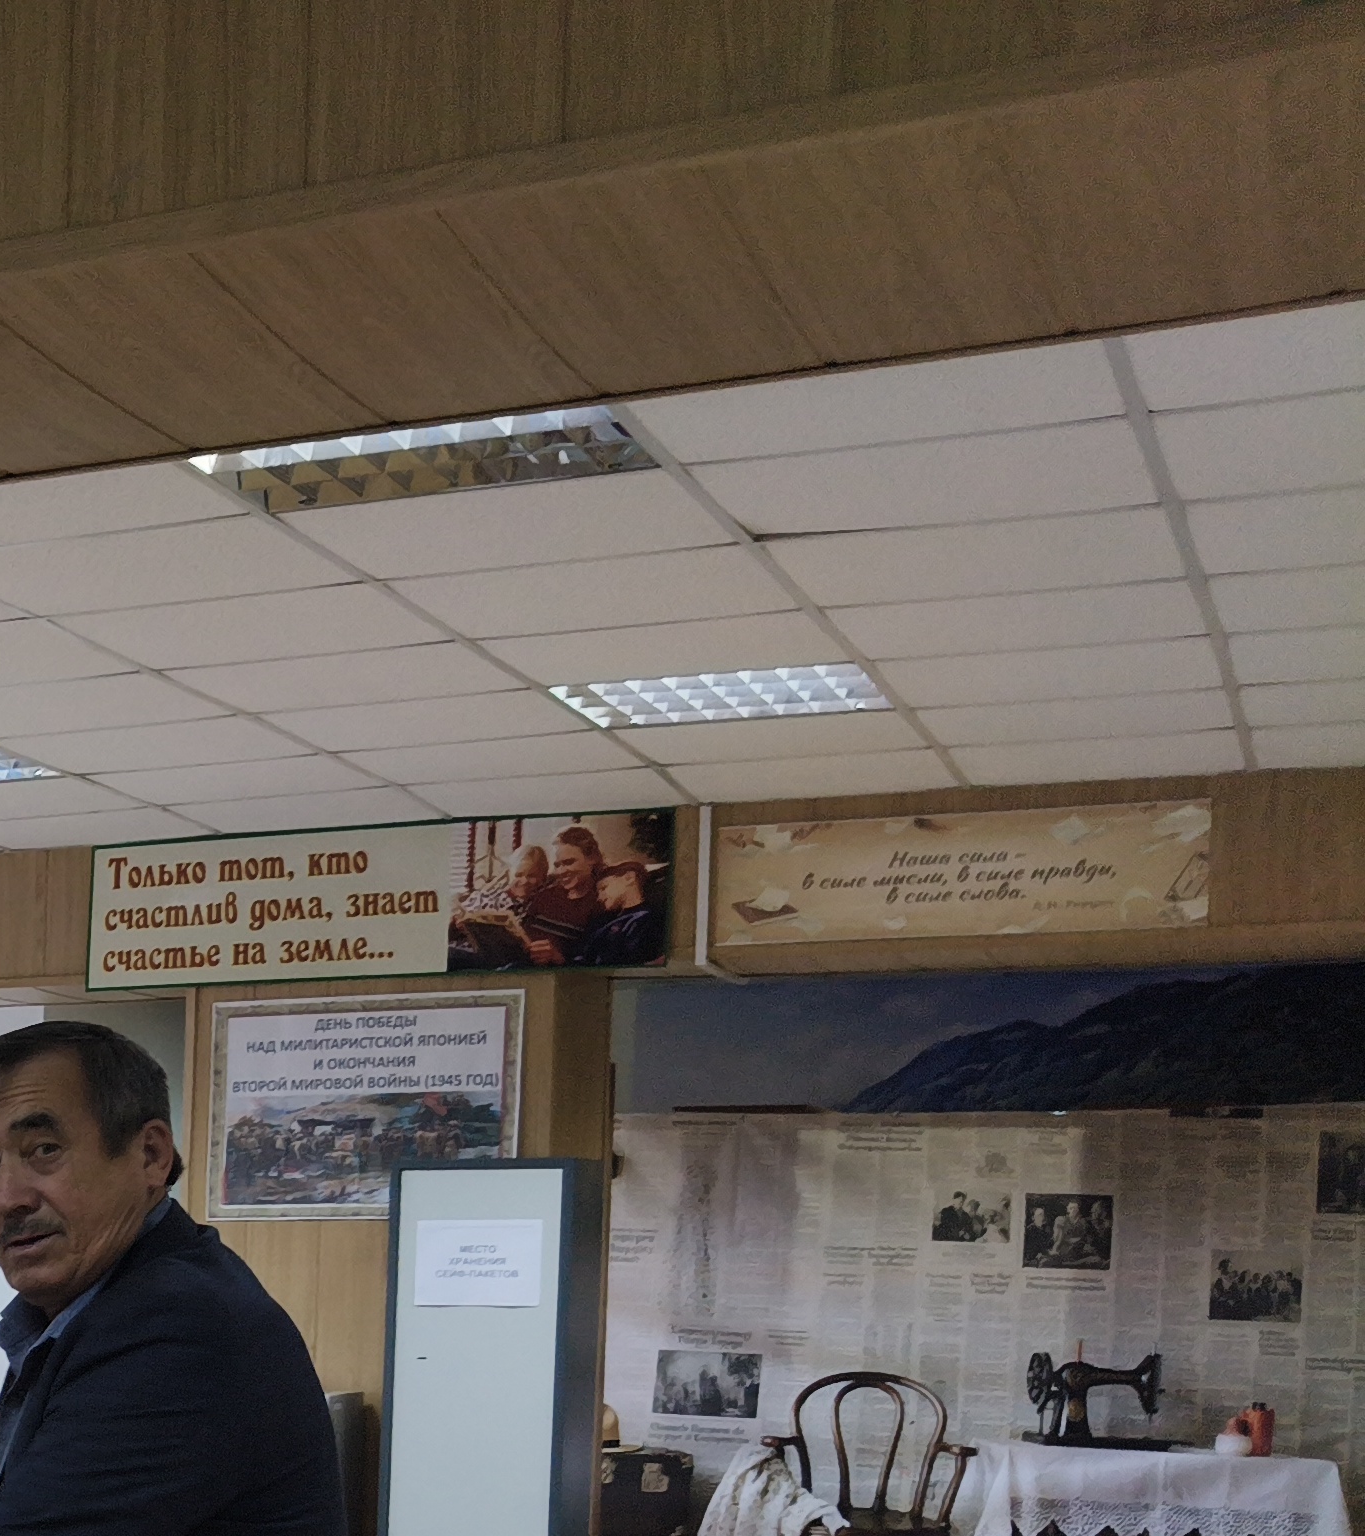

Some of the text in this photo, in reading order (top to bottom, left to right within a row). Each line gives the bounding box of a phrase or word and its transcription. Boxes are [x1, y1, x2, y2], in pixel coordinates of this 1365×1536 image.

[108, 850, 369, 891] Только тот, кто
[104, 888, 440, 932] счастлив дома, знает
[103, 936, 395, 973] счастье на земле...
[314, 1015, 418, 1032] ДЕНЬ ПОБЕДЫ
[246, 1041, 277, 1054] НАД
[417, 1028, 488, 1047] ЯПОНИЕЙ
[327, 1055, 417, 1071] ОКОНЧАНИЯ
[232, 1077, 288, 1093] ВТОРОЙ
[290, 1073, 365, 1091] МИРОВОЙ
[367, 1072, 421, 1089] ВОЙНЫ
